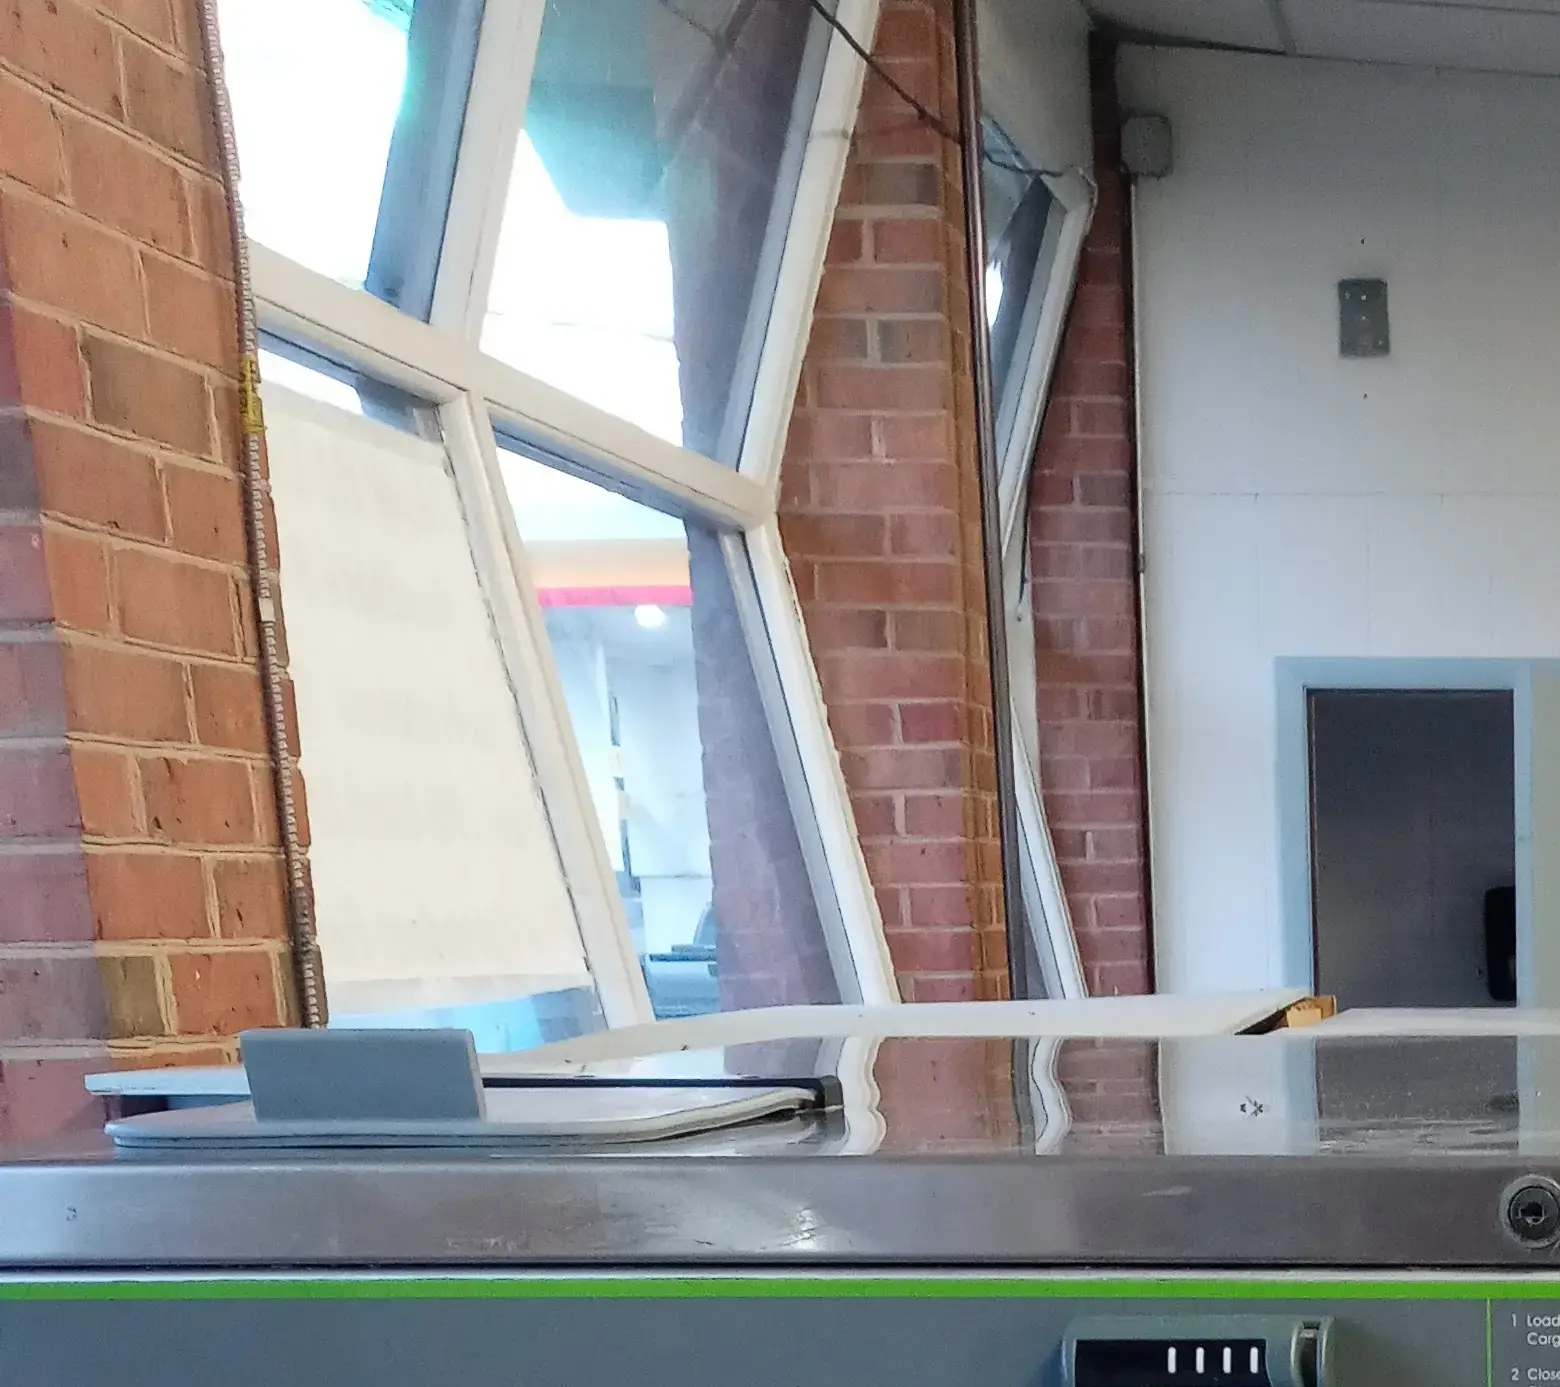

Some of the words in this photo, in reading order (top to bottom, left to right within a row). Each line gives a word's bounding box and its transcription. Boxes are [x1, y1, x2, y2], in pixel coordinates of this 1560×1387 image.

[1510, 1314, 1517, 1327] 1
[1527, 1314, 1560, 1327] Load
[1511, 1368, 1519, 1381] 2
